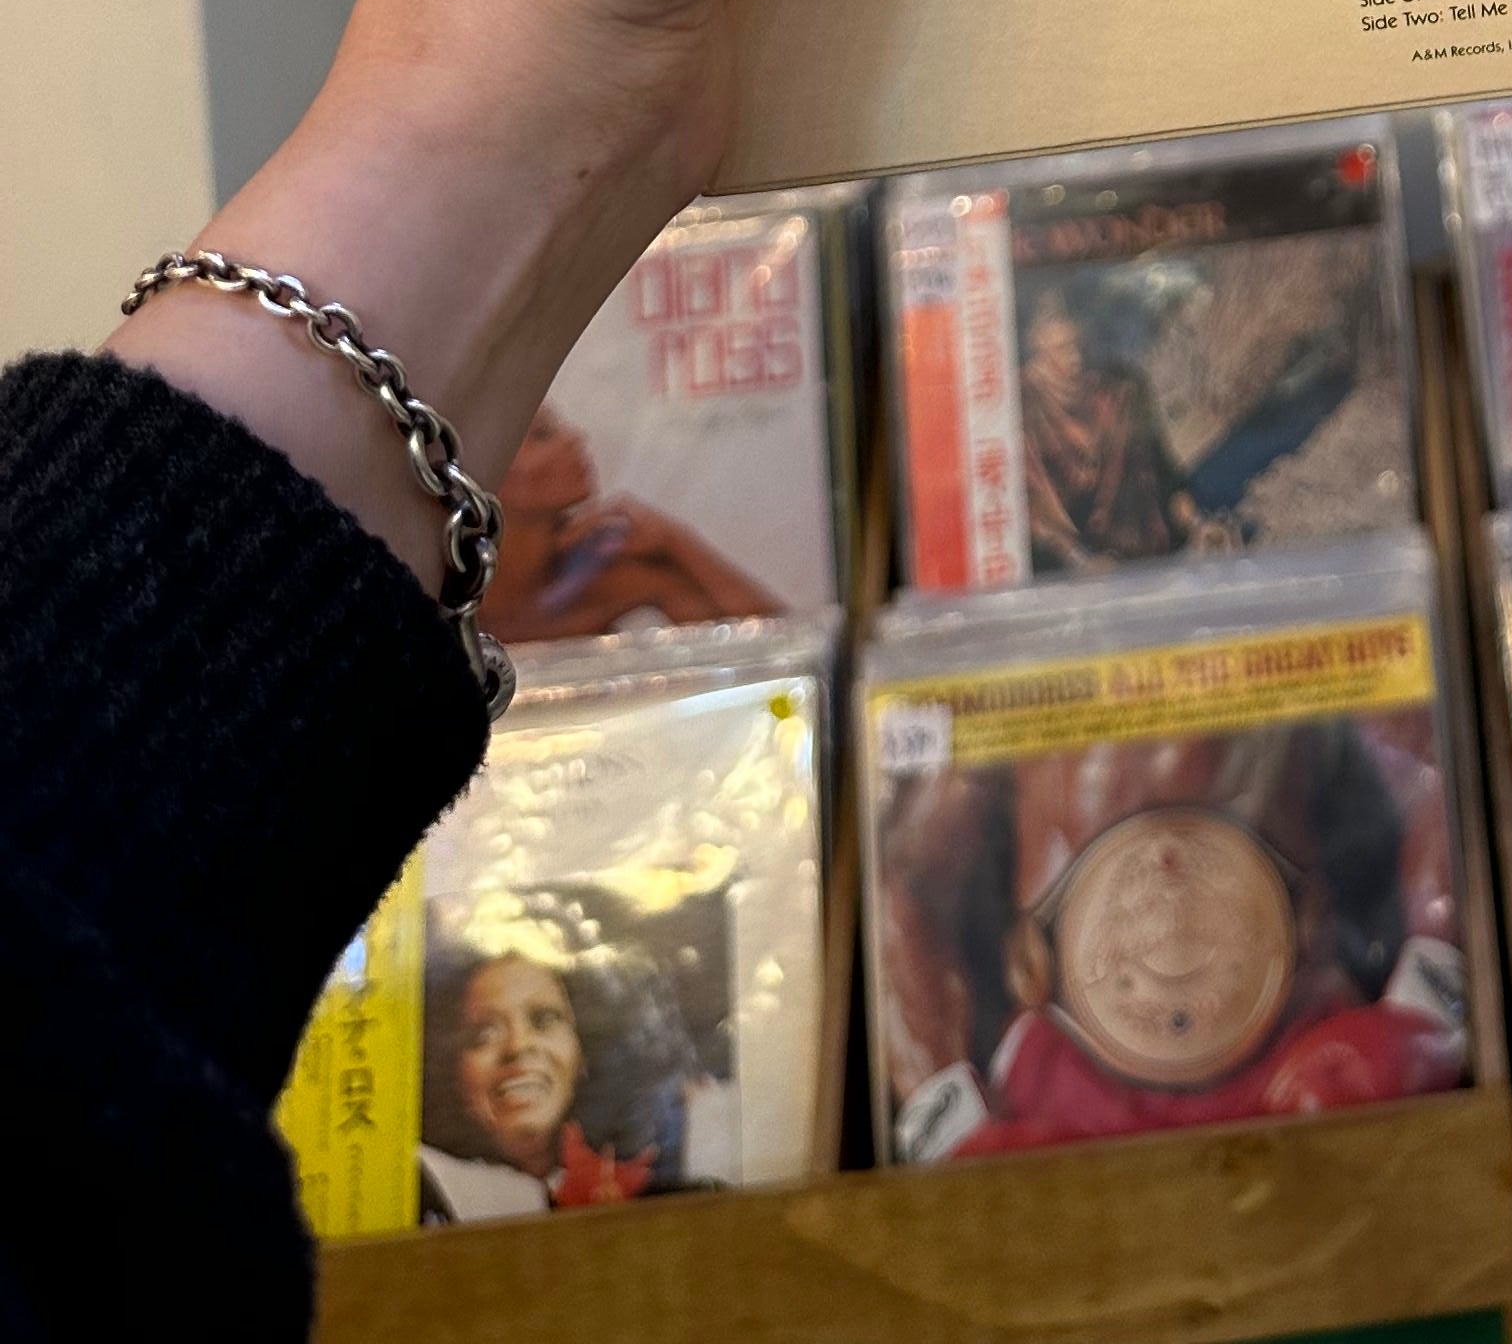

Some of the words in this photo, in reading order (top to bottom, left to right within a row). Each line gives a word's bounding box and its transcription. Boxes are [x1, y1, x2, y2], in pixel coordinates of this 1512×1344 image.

[1361, 14, 1398, 32] Side
[1402, 11, 1443, 27] Two:
[1449, 3, 1476, 21] Tell
[1481, 1, 1508, 18] Me
[1411, 47, 1448, 62] A&M
[1450, 41, 1505, 58] Records,
